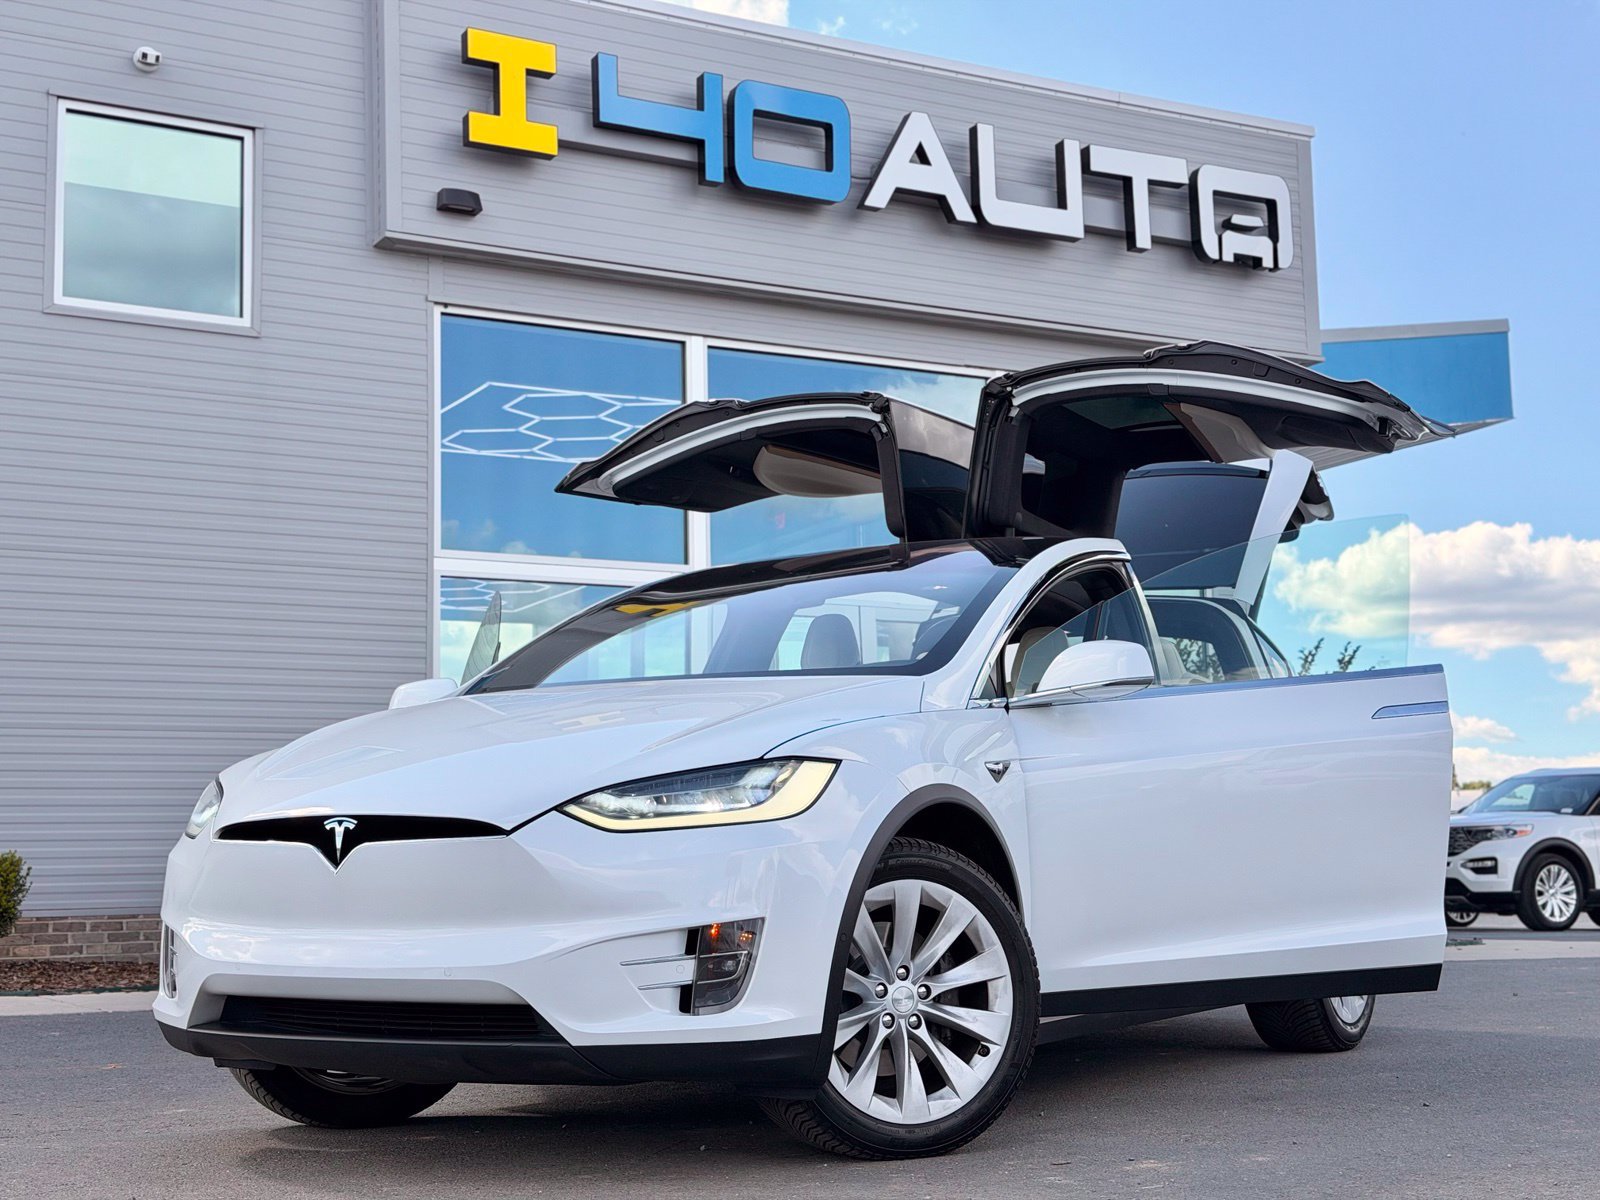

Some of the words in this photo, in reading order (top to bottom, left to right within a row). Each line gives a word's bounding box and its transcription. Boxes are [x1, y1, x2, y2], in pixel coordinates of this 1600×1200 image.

[462, 27, 559, 159] I
[592, 52, 852, 204] 40
[859, 111, 1294, 272] AUTO
